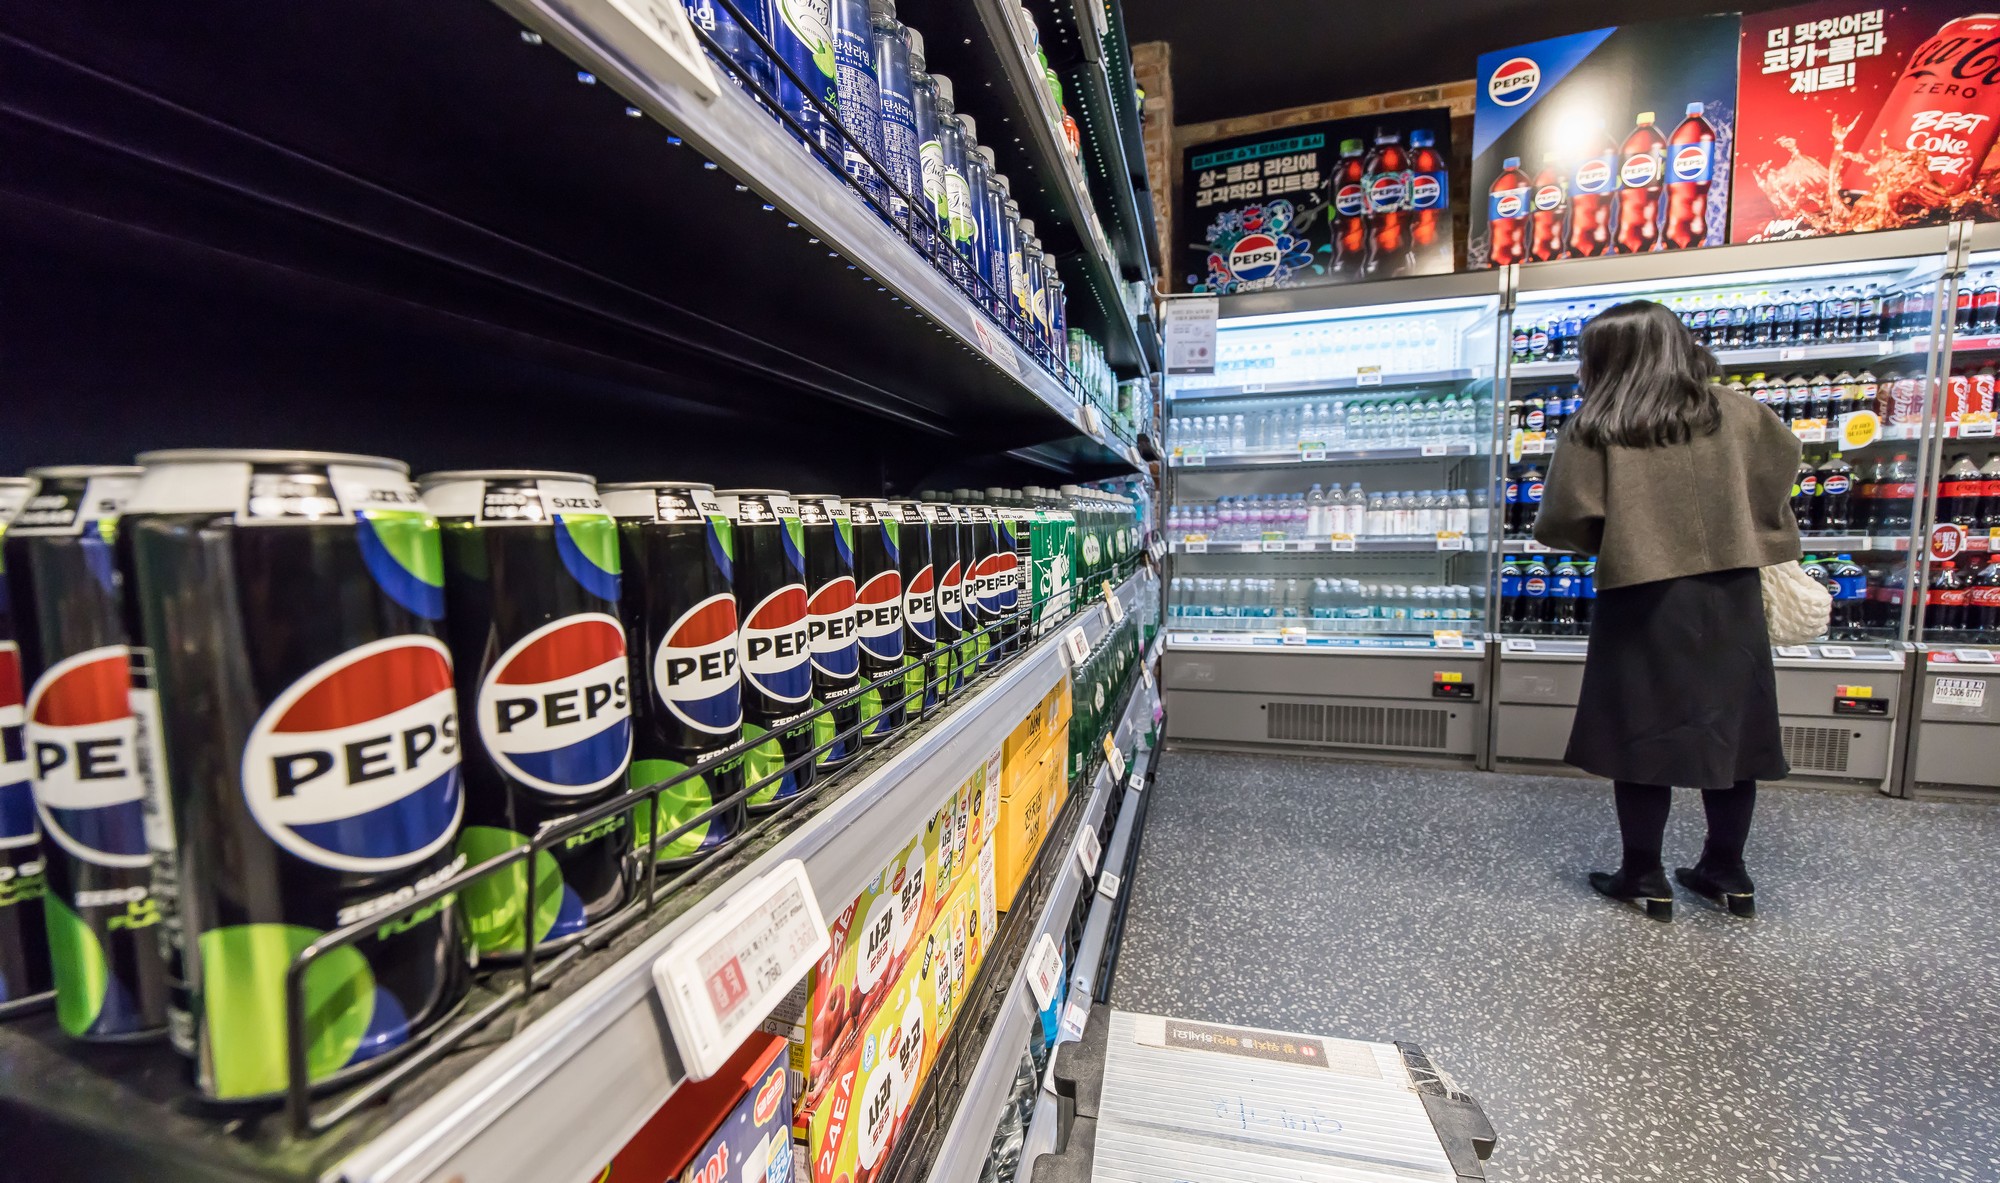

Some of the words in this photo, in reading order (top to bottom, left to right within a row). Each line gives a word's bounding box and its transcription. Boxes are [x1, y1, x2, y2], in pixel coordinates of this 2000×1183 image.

[1768, 26, 1790, 48] 더
[1795, 9, 1884, 44] 맛있어진
[1762, 30, 1888, 75] 코카-콜라
[1493, 74, 1535, 90] PEPSI
[1789, 61, 1857, 94] 제로!
[1914, 83, 1977, 98] ZERO
[1911, 110, 1990, 134] BEST
[1906, 131, 1968, 155] Coke
[1199, 161, 1262, 188] 상-큼한
[1264, 152, 1318, 177] 라임에
[1196, 180, 1263, 208] 감각적인
[1266, 171, 1321, 196] 민트향
[1233, 252, 1278, 266] PEPSI
[553, 498, 590, 509] SIZE
[825, 688, 848, 700] ZERO
[34, 737, 128, 781] PE
[901, 867, 923, 913] 망고
[821, 900, 855, 978] 24E
[866, 907, 893, 960] 사과
[869, 940, 889, 974] 드링크
[900, 1017, 921, 1072] 망고
[820, 1070, 855, 1175] 24EA
[867, 1072, 892, 1136] 사과
[872, 1105, 890, 1147] 드링크
